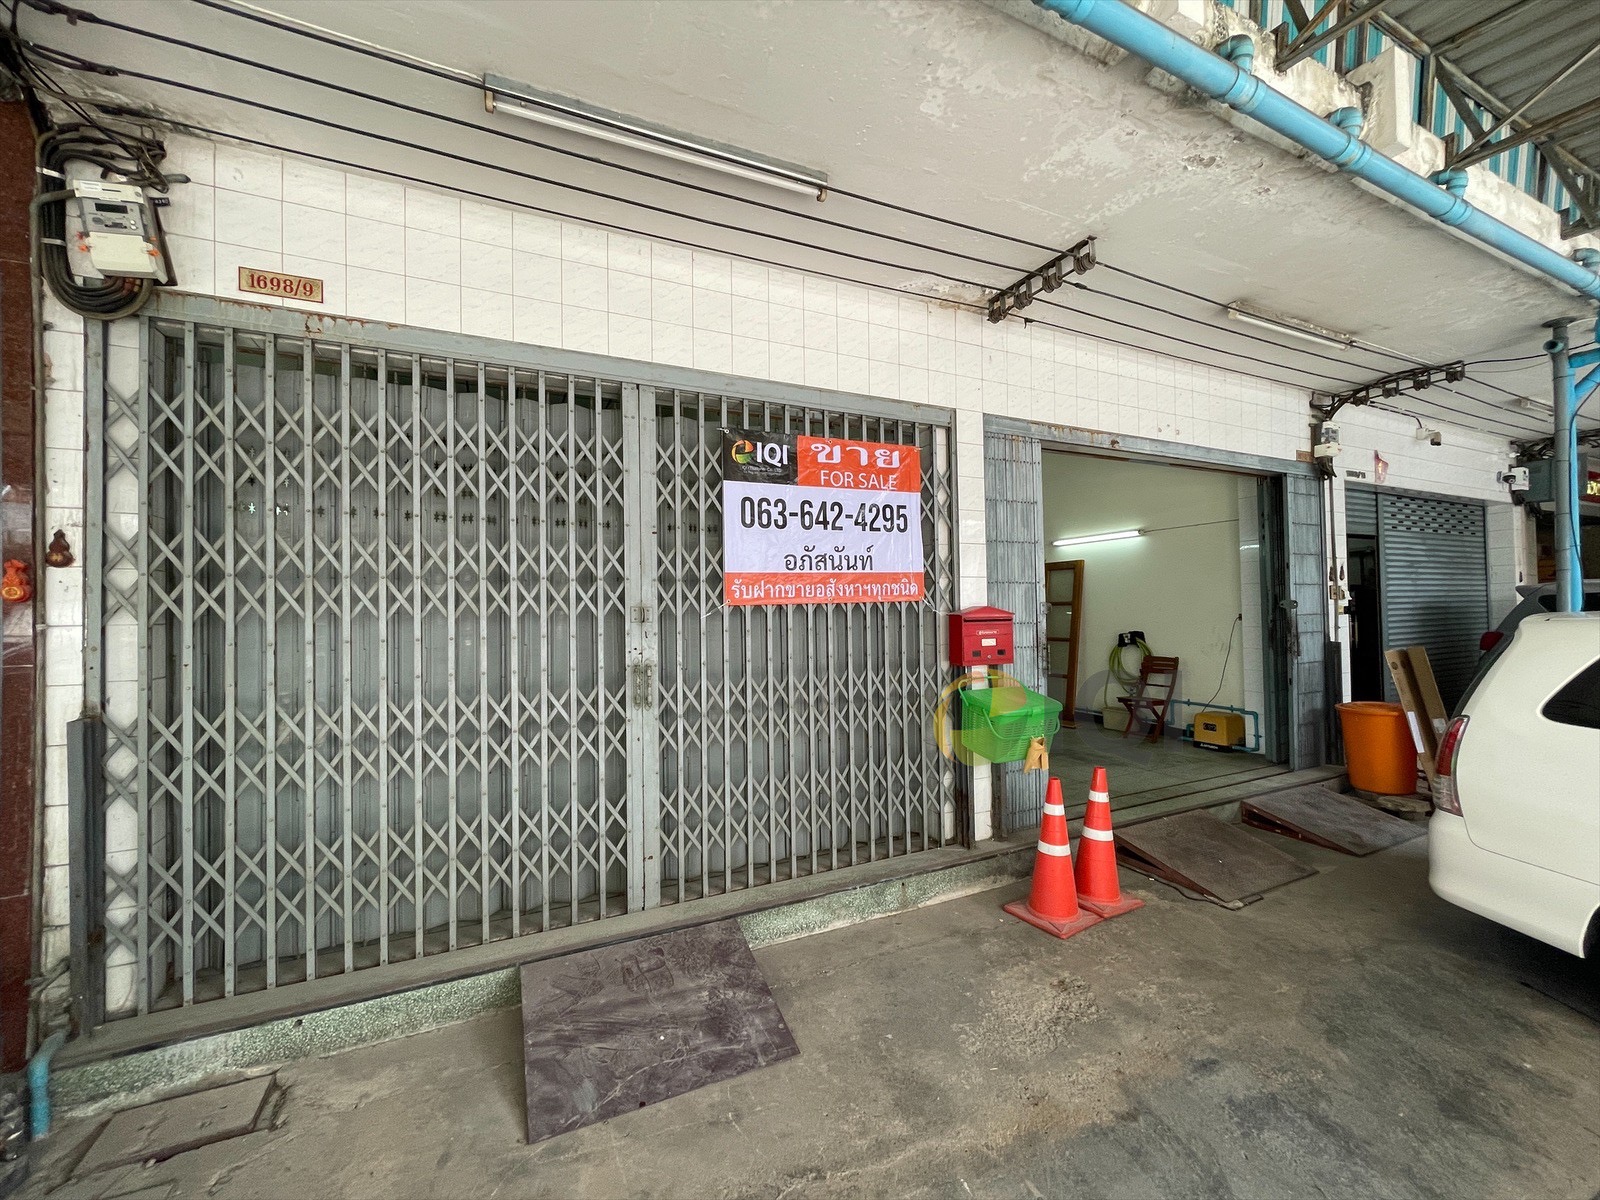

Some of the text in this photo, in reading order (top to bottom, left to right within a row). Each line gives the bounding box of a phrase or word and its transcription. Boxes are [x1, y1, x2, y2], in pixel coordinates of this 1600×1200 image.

[249, 273, 314, 297] 1698/9
[756, 442, 789, 467] IQI
[811, 443, 900, 469] ขาย
[820, 470, 898, 490] FOR SALE
[740, 496, 908, 533] 063-642-4295
[783, 544, 874, 571] อภัสนันท์
